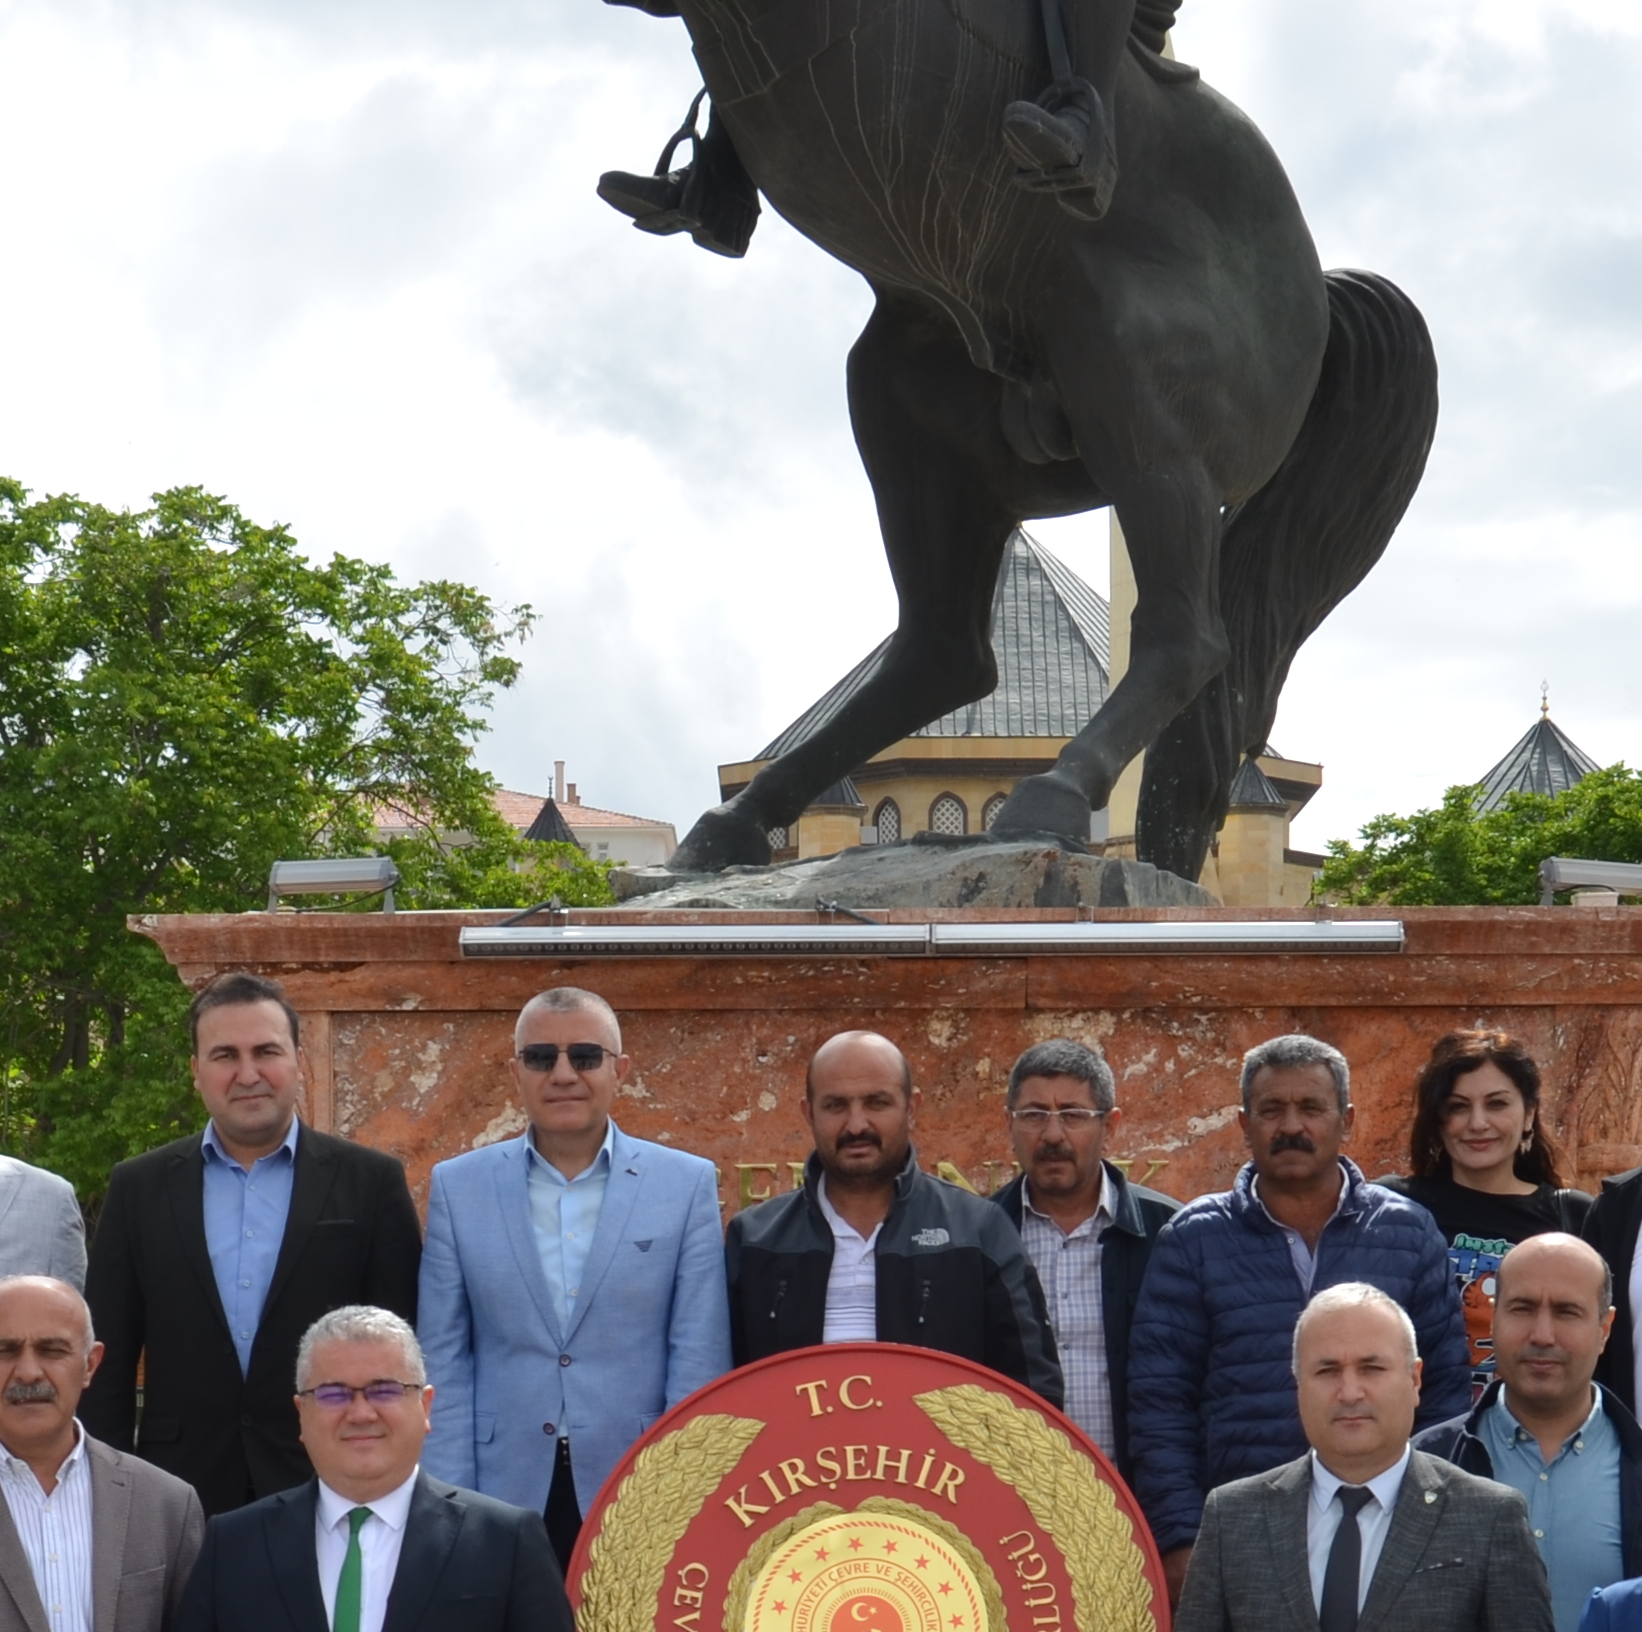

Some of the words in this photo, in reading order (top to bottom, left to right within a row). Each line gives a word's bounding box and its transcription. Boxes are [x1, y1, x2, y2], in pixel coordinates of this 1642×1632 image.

[796, 1375, 883, 1416] T.C.
[723, 1445, 967, 1528] KIRŞEHİR
[828, 1563, 870, 1583] ÇEVRE
[876, 1563, 892, 1577] VE
[894, 1571, 938, 1632] ŞEHİRCİLİK
